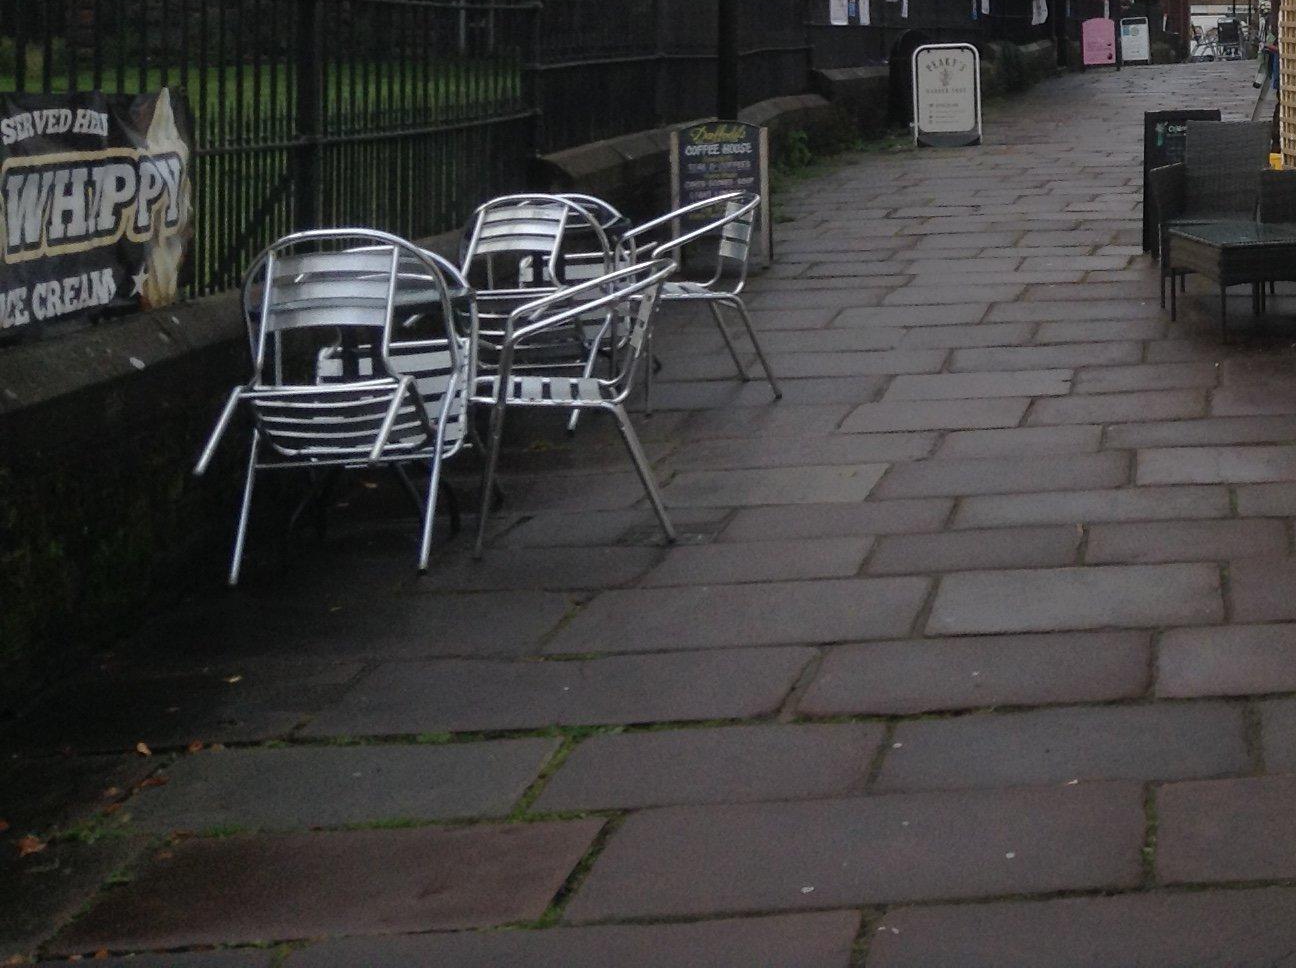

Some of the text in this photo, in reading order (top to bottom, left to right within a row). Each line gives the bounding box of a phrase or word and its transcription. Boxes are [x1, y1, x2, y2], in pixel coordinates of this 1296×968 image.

[0, 108, 72, 145] SERVED
[686, 144, 720, 155] COFFEE
[6, 157, 181, 247] WHIPPY
[32, 267, 117, 320] CREAM
